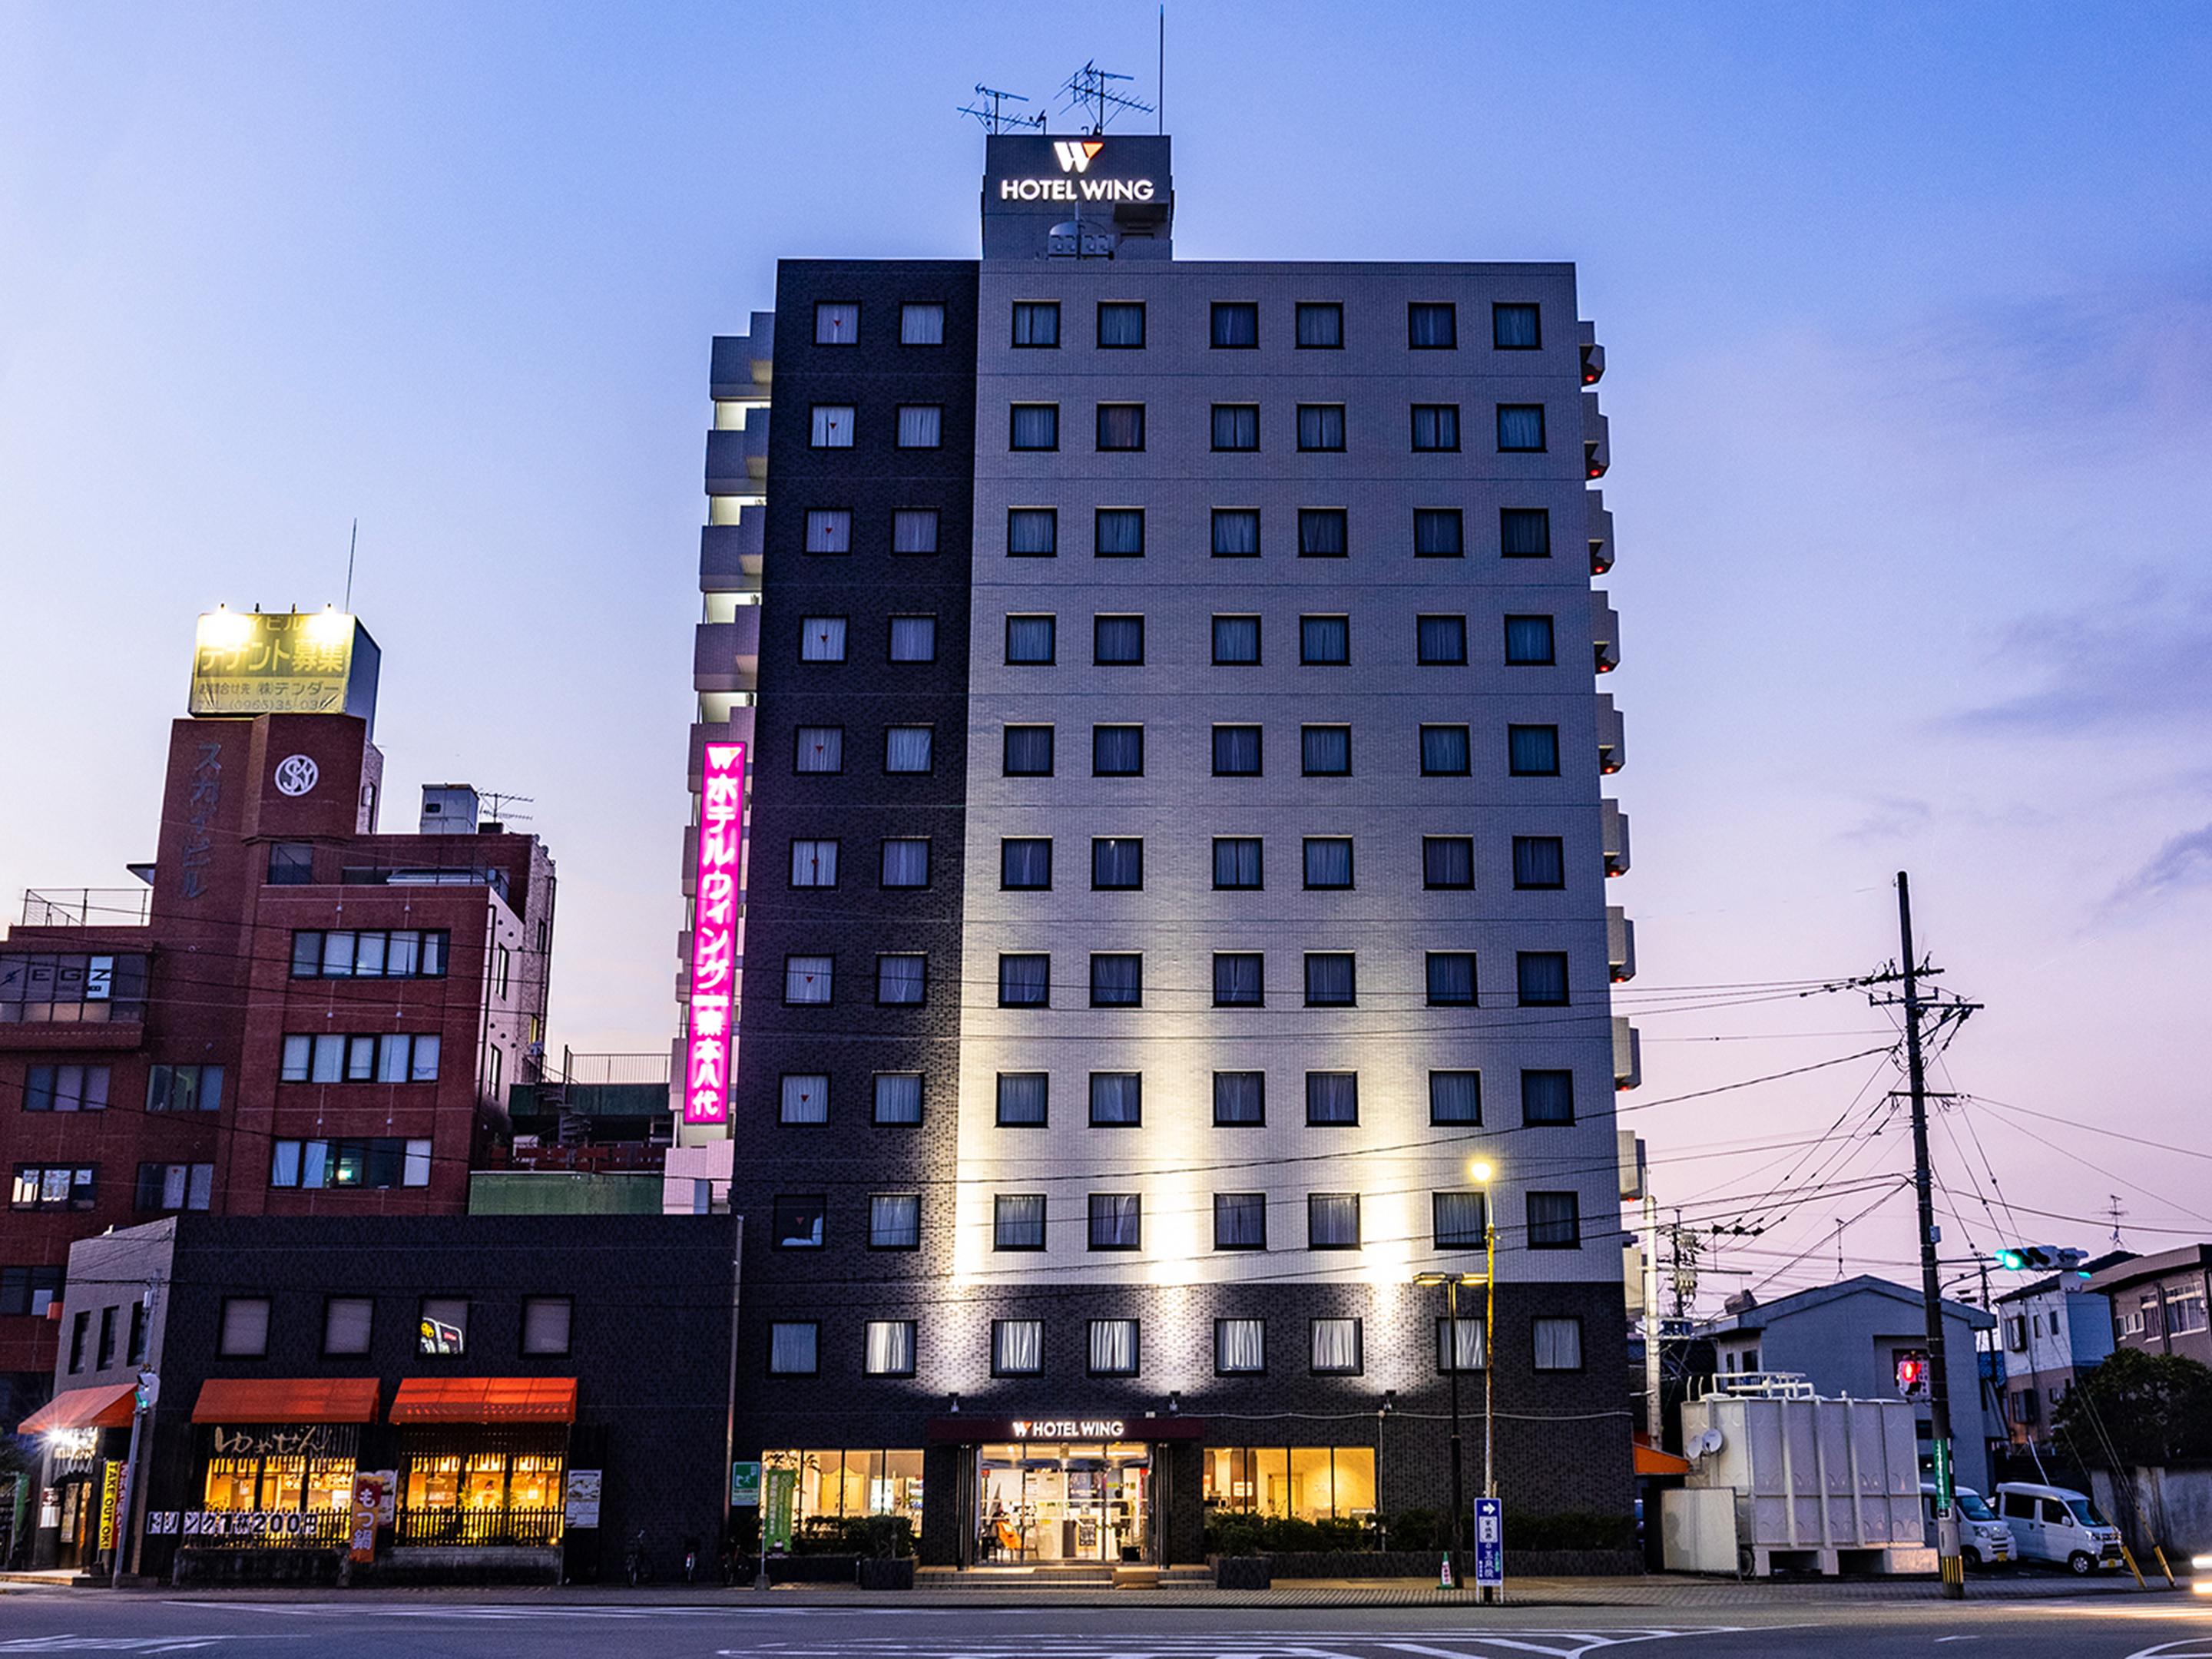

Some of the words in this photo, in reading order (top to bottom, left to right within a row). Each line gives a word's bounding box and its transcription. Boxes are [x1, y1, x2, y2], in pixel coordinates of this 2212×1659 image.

[1001, 180, 1078, 200] HOTEL
[1080, 180, 1154, 200] WING
[201, 638, 344, 672] テナント募集
[1032, 1421, 1079, 1437] HOTEL
[1080, 1421, 1124, 1437] WING
[106, 1464, 118, 1495] TAKE
[103, 1498, 114, 1522] OUT
[353, 1488, 375, 1549] もつ鍋
[101, 1525, 111, 1547] OK!
